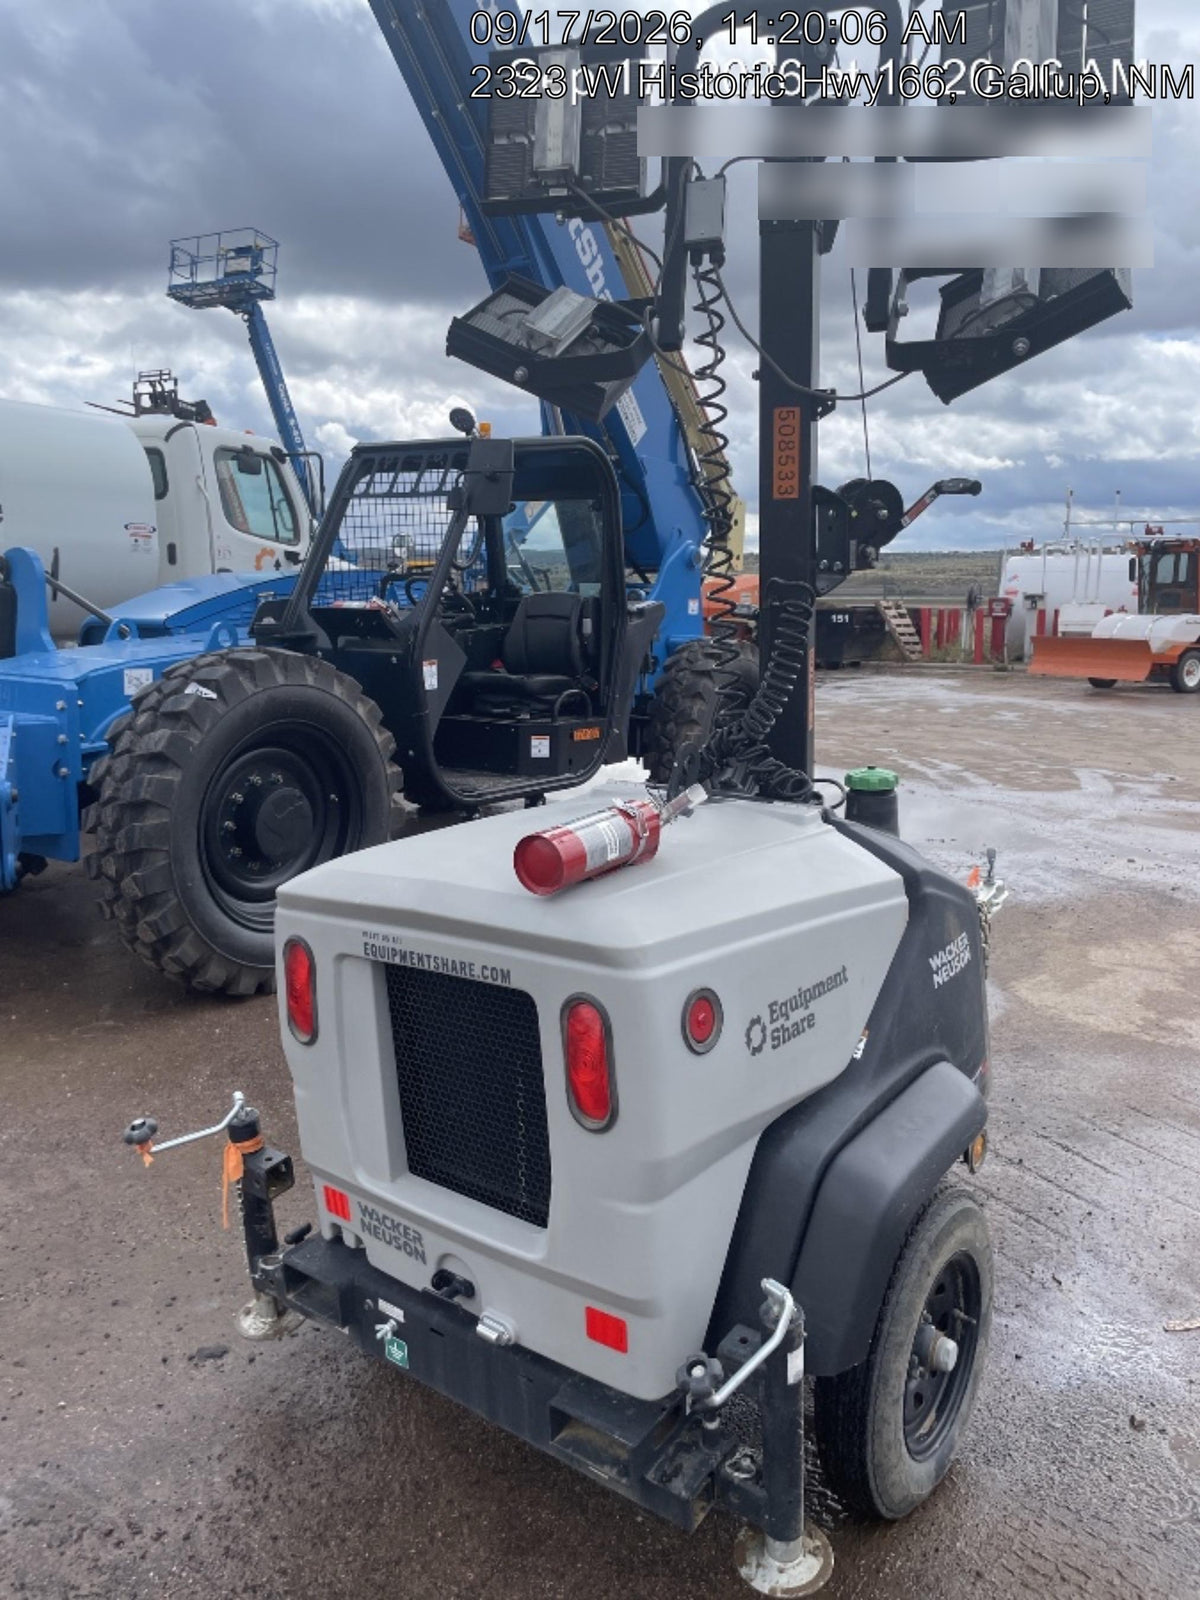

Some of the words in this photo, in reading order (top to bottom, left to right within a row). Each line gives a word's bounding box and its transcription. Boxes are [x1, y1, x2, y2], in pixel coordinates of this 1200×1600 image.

[778, 409, 796, 496] 508533
[831, 614, 849, 623] 151
[363, 941, 512, 985] EQUIPMENTSHARE.COM
[928, 931, 969, 971] WACKER
[933, 945, 972, 989] NEUSON
[768, 964, 848, 1025] Equipment
[770, 1012, 816, 1050] Share
[357, 1201, 424, 1248] WACKER
[360, 1218, 427, 1265] NEUSON
